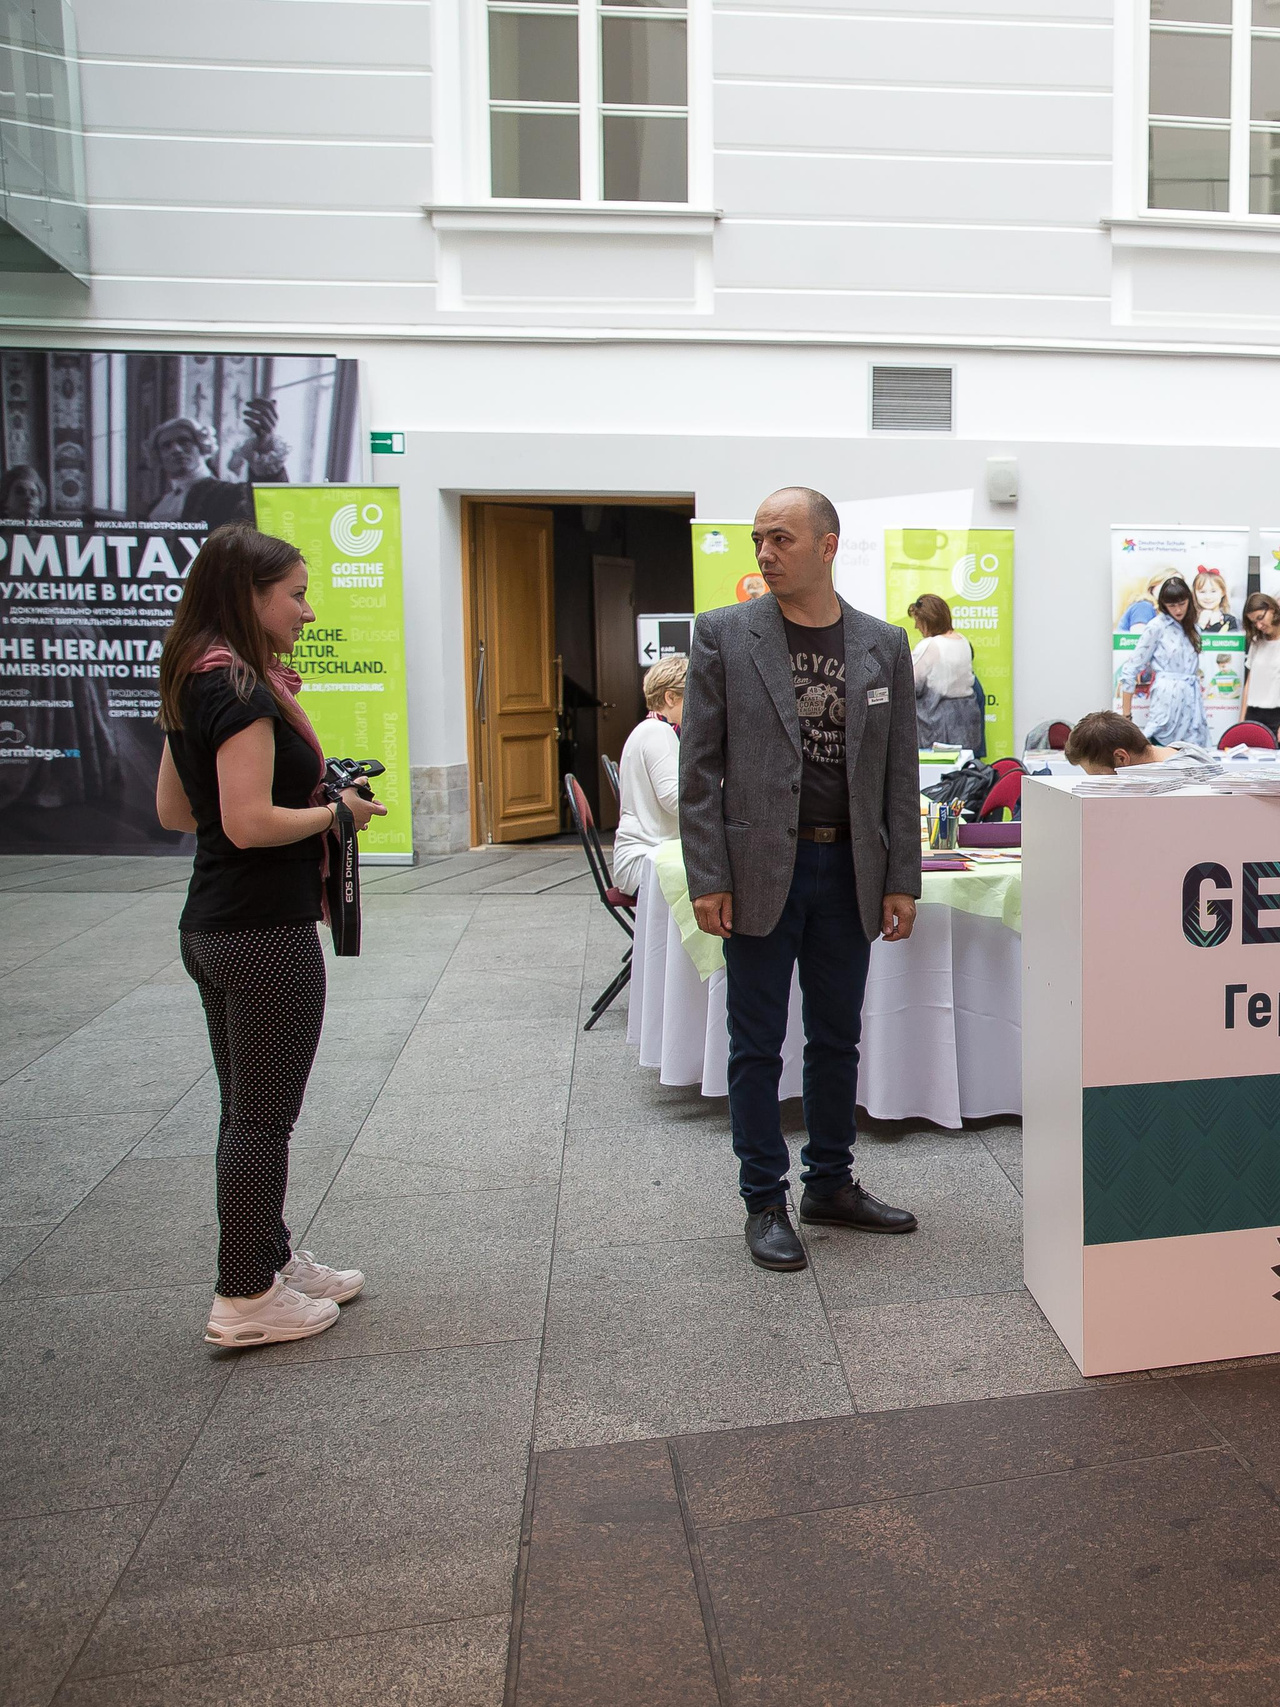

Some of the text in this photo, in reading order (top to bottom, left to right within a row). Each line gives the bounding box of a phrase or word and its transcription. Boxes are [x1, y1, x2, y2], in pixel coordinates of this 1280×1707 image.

[841, 538, 877, 553] Кафе
[331, 562, 384, 575] GOETHE
[331, 576, 385, 588] INSTITUT
[101, 583, 118, 601] В
[122, 584, 186, 603] ИСТО
[952, 606, 999, 618] GOETHE
[952, 618, 999, 630] INSTITUT
[298, 628, 348, 641] RACHE.
[42, 638, 164, 661] HERMITA
[293, 645, 339, 658] ULTUR.
[87, 664, 130, 678] INTO
[290, 661, 387, 674] EUTSCHLAND.
[367, 830, 406, 844] Berlin
[345, 837, 354, 903] EOS DIGITAL
